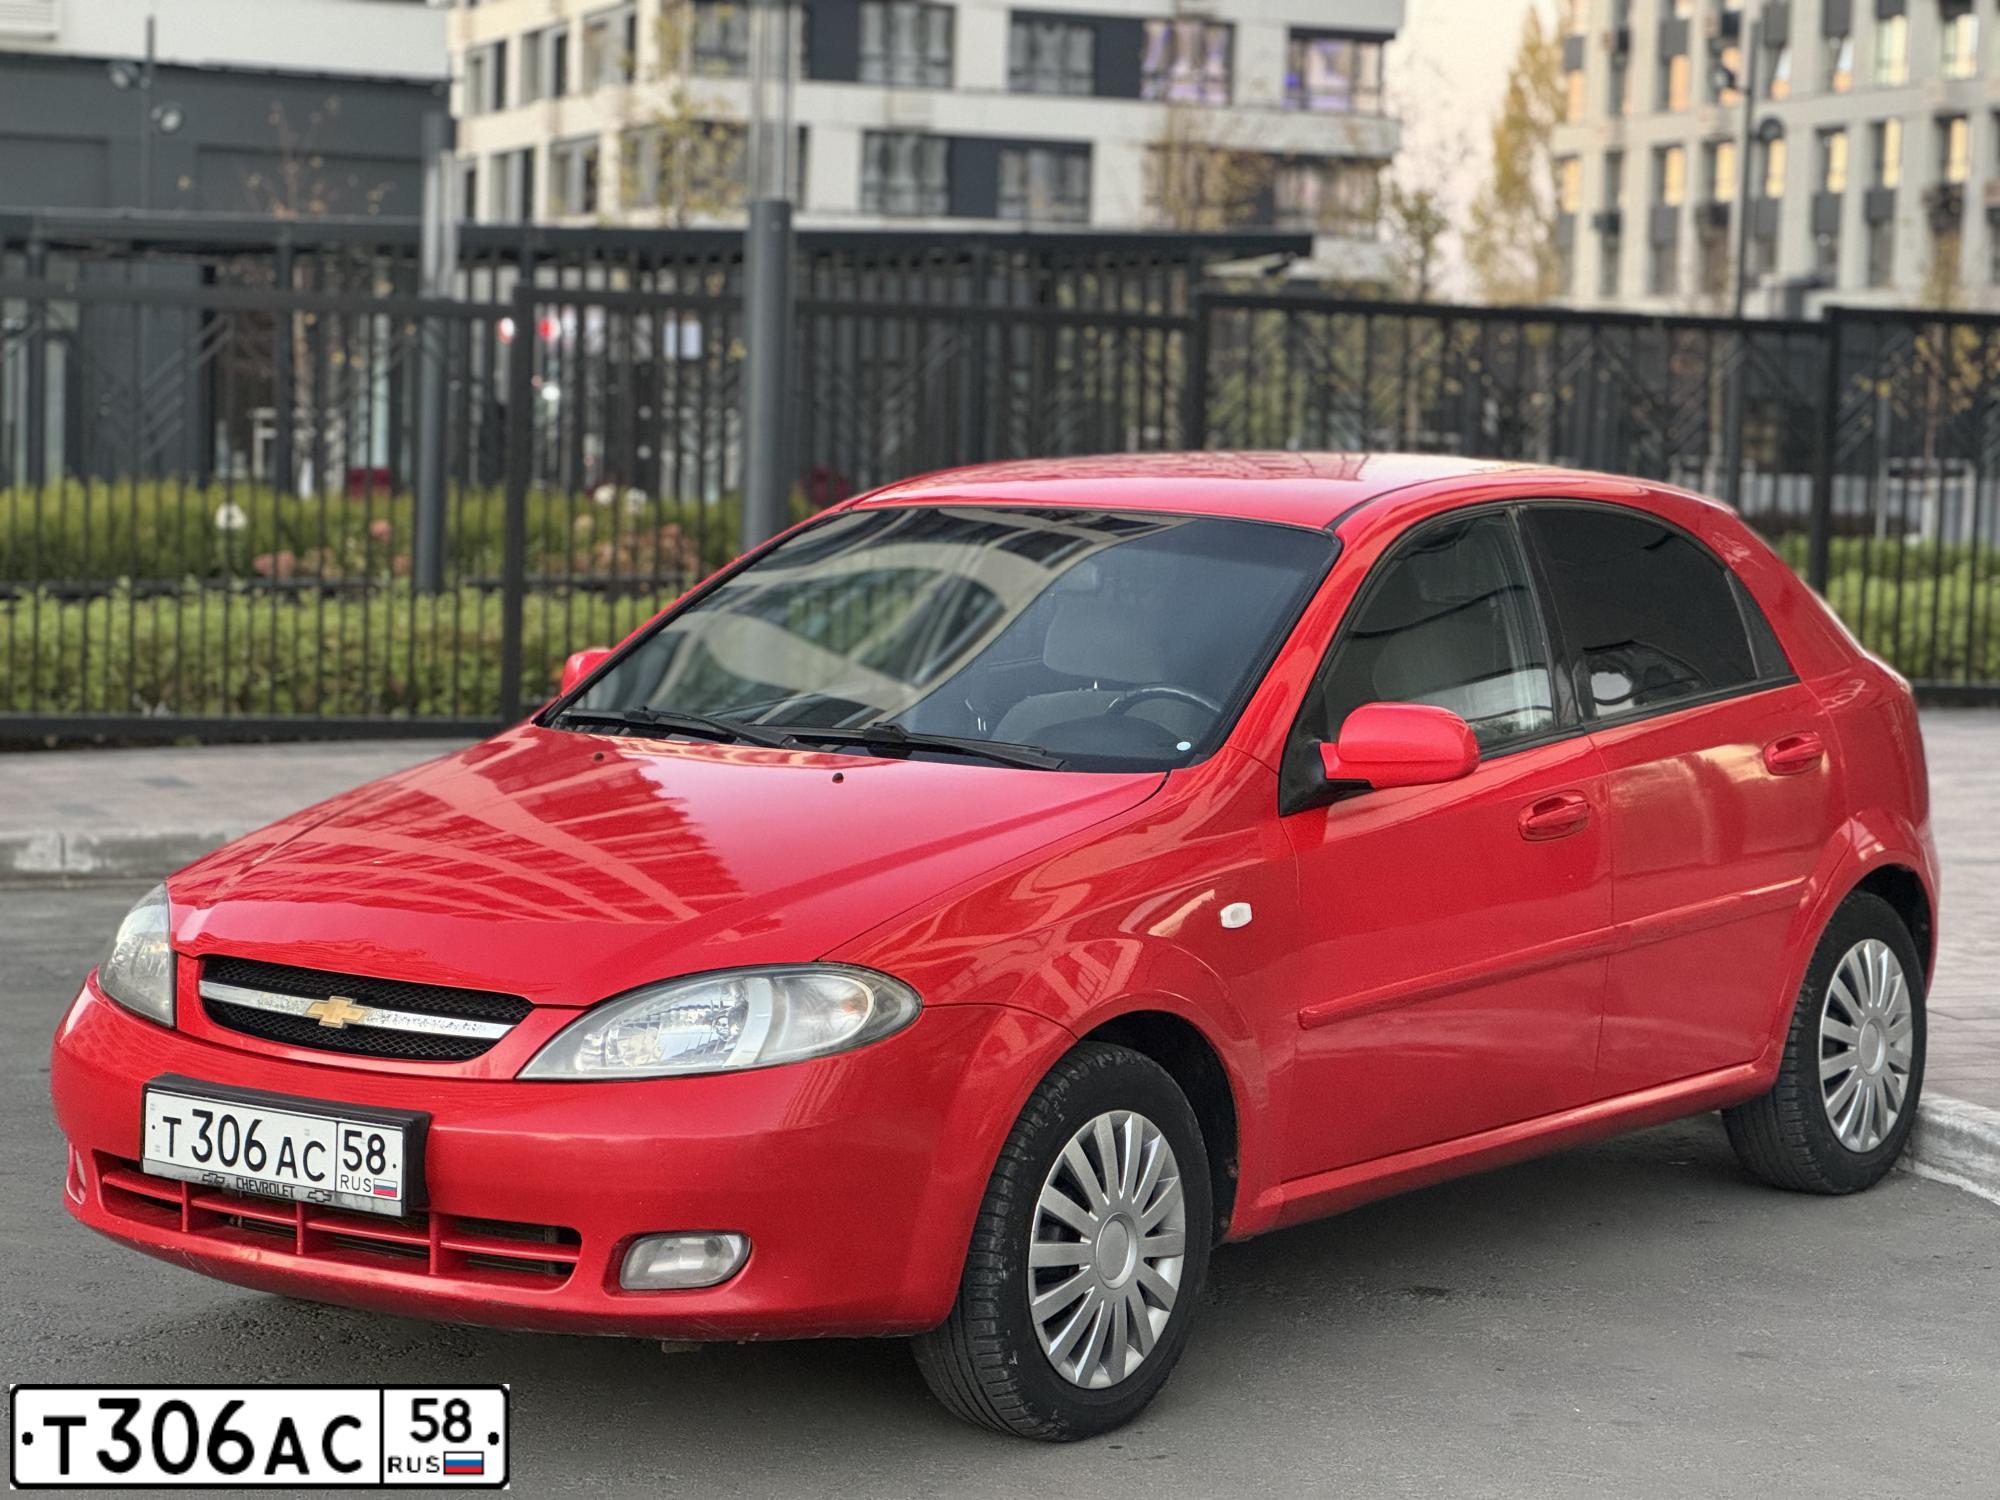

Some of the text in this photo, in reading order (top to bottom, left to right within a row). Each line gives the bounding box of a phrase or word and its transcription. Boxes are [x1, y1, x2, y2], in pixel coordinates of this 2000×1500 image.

[342, 1129, 386, 1176] 58
[236, 1177, 295, 1199] CHEVROLET
[340, 1174, 372, 1193] RUS
